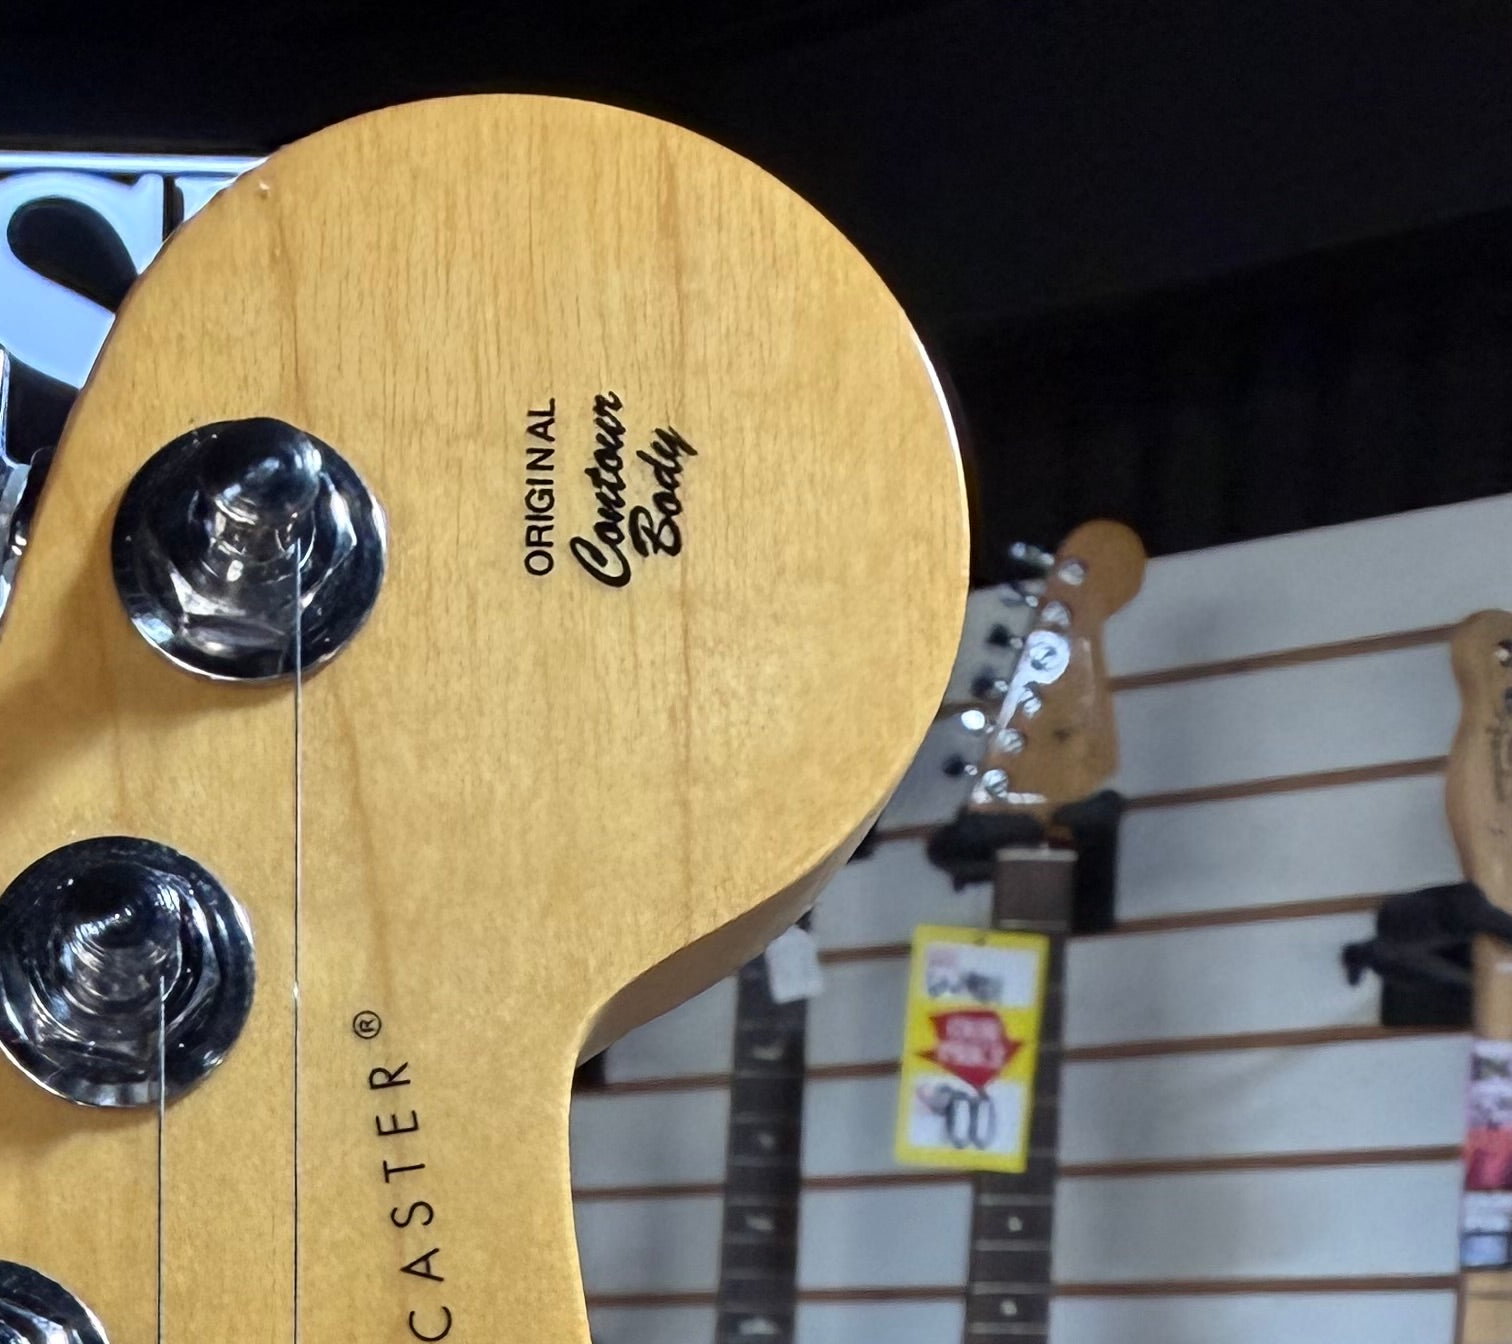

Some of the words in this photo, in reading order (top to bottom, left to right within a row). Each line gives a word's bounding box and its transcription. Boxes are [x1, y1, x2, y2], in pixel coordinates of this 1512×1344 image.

[524, 397, 556, 577] ORIGINAL
[569, 390, 632, 588] Contour
[628, 425, 698, 558] Body
